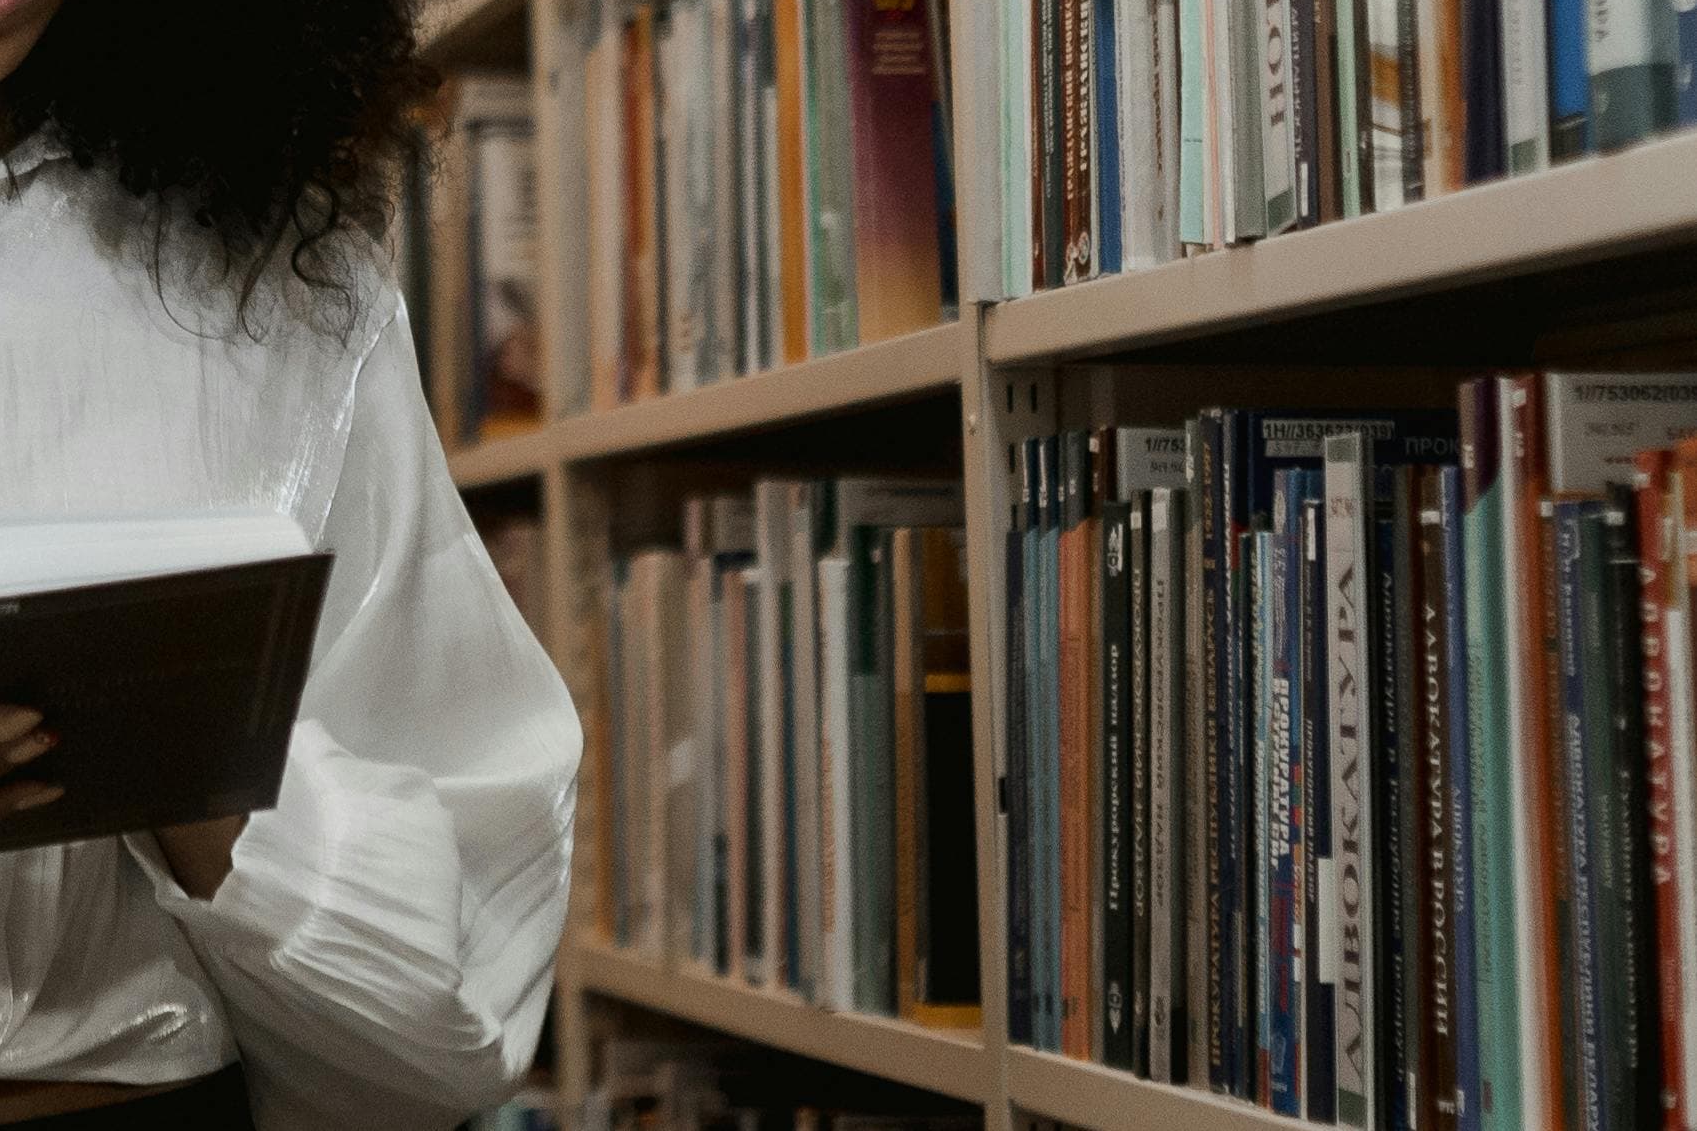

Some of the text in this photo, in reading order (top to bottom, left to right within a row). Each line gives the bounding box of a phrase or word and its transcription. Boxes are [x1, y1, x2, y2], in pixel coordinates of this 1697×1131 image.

[1066, 71, 1074, 200] ГРАЖДАНСКИЙ
[1223, 464, 1231, 623] ПРОКУРАТУРА
[1134, 569, 1144, 916] ПРОКУРОРСКИЙ НАДЗОР
[1226, 636, 1234, 748] МИНСКОЙ
[1279, 678, 1289, 854] ПРОКУРАТУРА
[1638, 567, 1671, 884] АДВОКАТУРА
[1109, 736, 1119, 910] Прокурорский
[1207, 589, 1221, 1065] ПРОКУРАТУРА РЕСПУБЛИКИ БЕЛАРУСЬ
[1338, 564, 1363, 1080] АДВОКАТУРА
[1426, 605, 1447, 1036] АДВОКАТУРА В РОССИИ
[1454, 787, 1464, 913] АДВОКАТУРА
